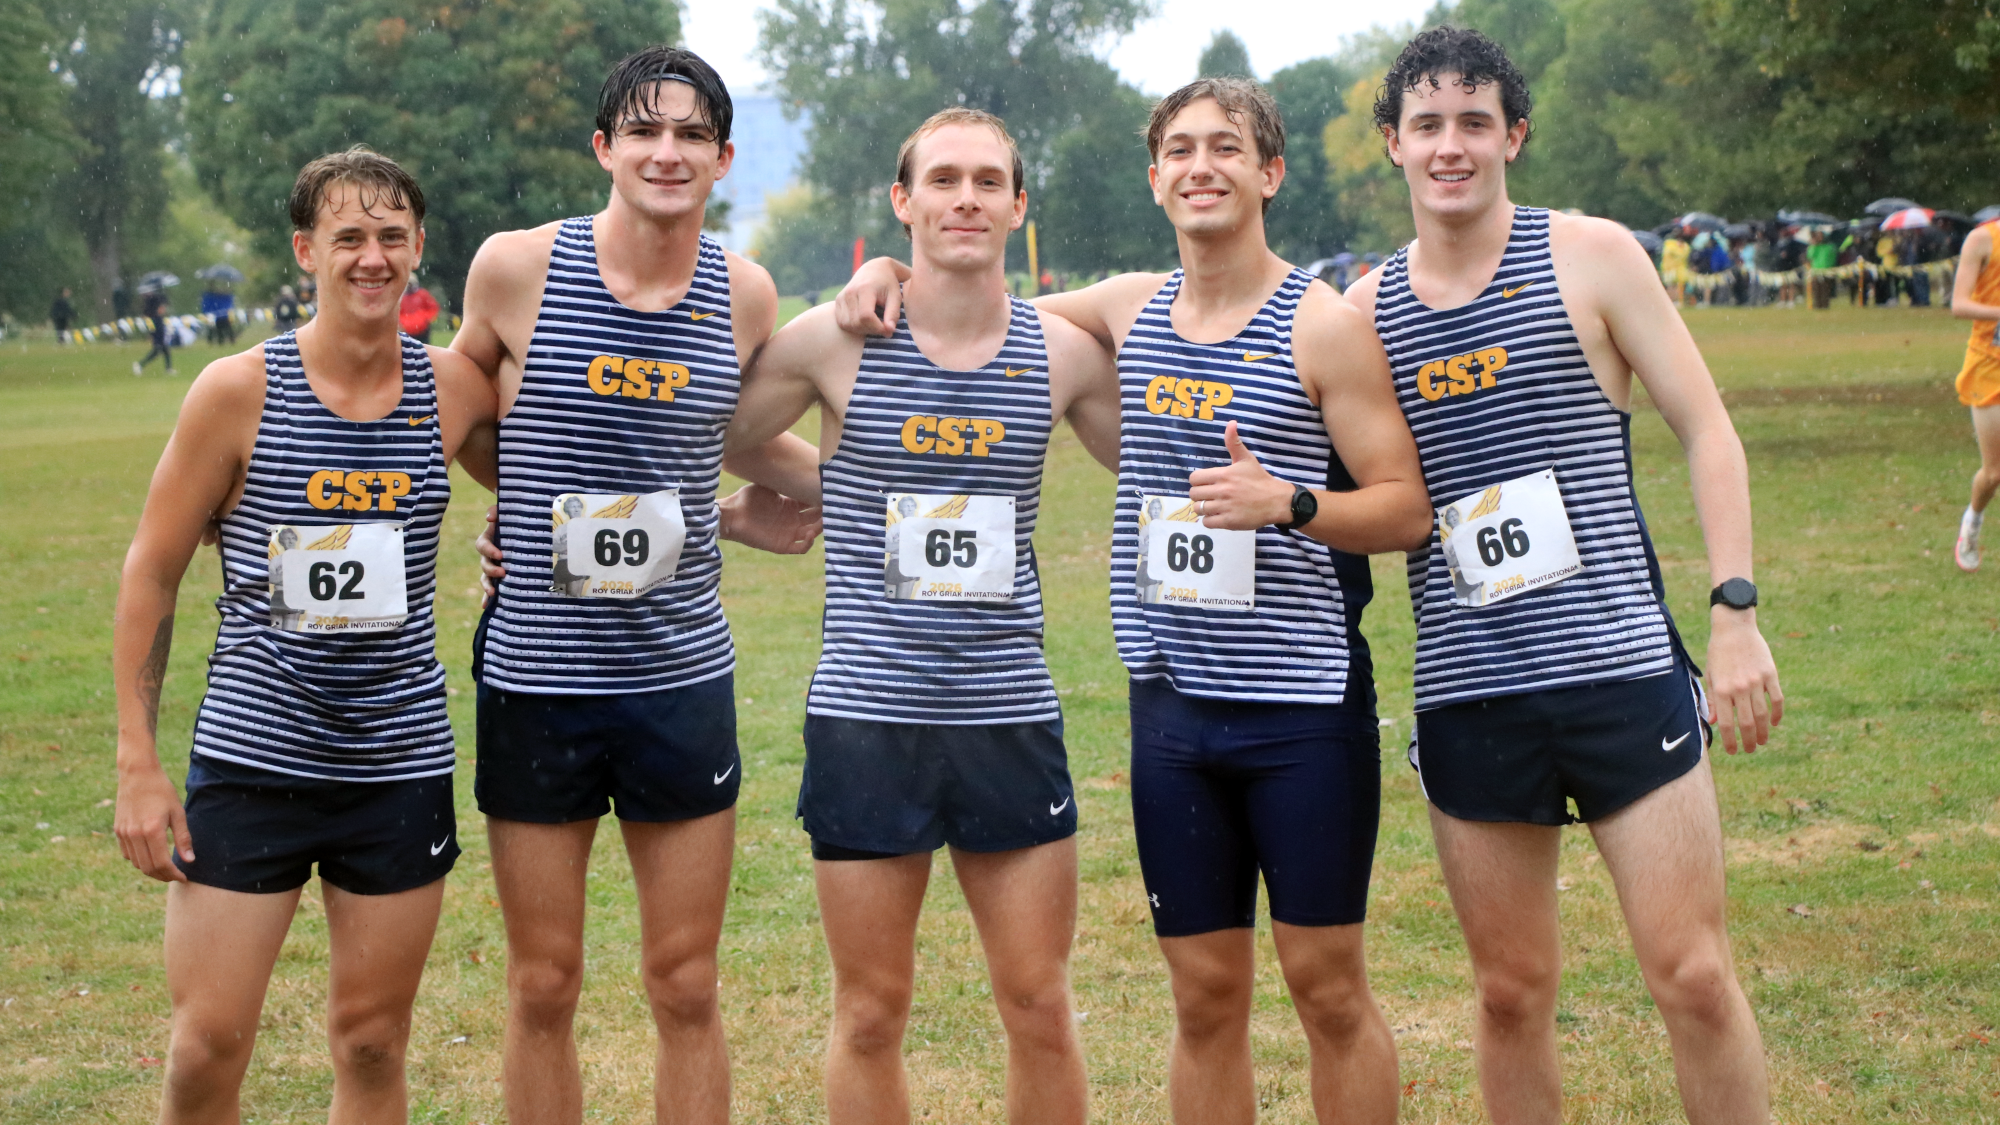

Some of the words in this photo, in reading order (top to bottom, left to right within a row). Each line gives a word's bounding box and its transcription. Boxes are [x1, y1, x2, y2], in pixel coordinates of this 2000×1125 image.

[587, 354, 690, 403] CSP
[1417, 346, 1508, 402] CSP
[1145, 375, 1234, 421] CSP
[901, 414, 1006, 457] CSP
[306, 469, 412, 512] CSP
[594, 528, 650, 567] 69
[925, 529, 978, 568] 65
[1167, 532, 1214, 574] 68
[1476, 517, 1530, 567] 66
[308, 560, 365, 601] 62
[600, 580, 634, 591] 2026
[929, 582, 963, 592] 2026
[1170, 587, 1198, 599] 2026
[1178, 595, 1198, 603] GRIAK
[1199, 598, 1251, 606] INVITATIONA
[1489, 590, 1503, 599] ROY
[1504, 582, 1526, 594] GRIAK
[1527, 564, 1579, 586] INVITATIONA
[1493, 574, 1525, 592] 2026
